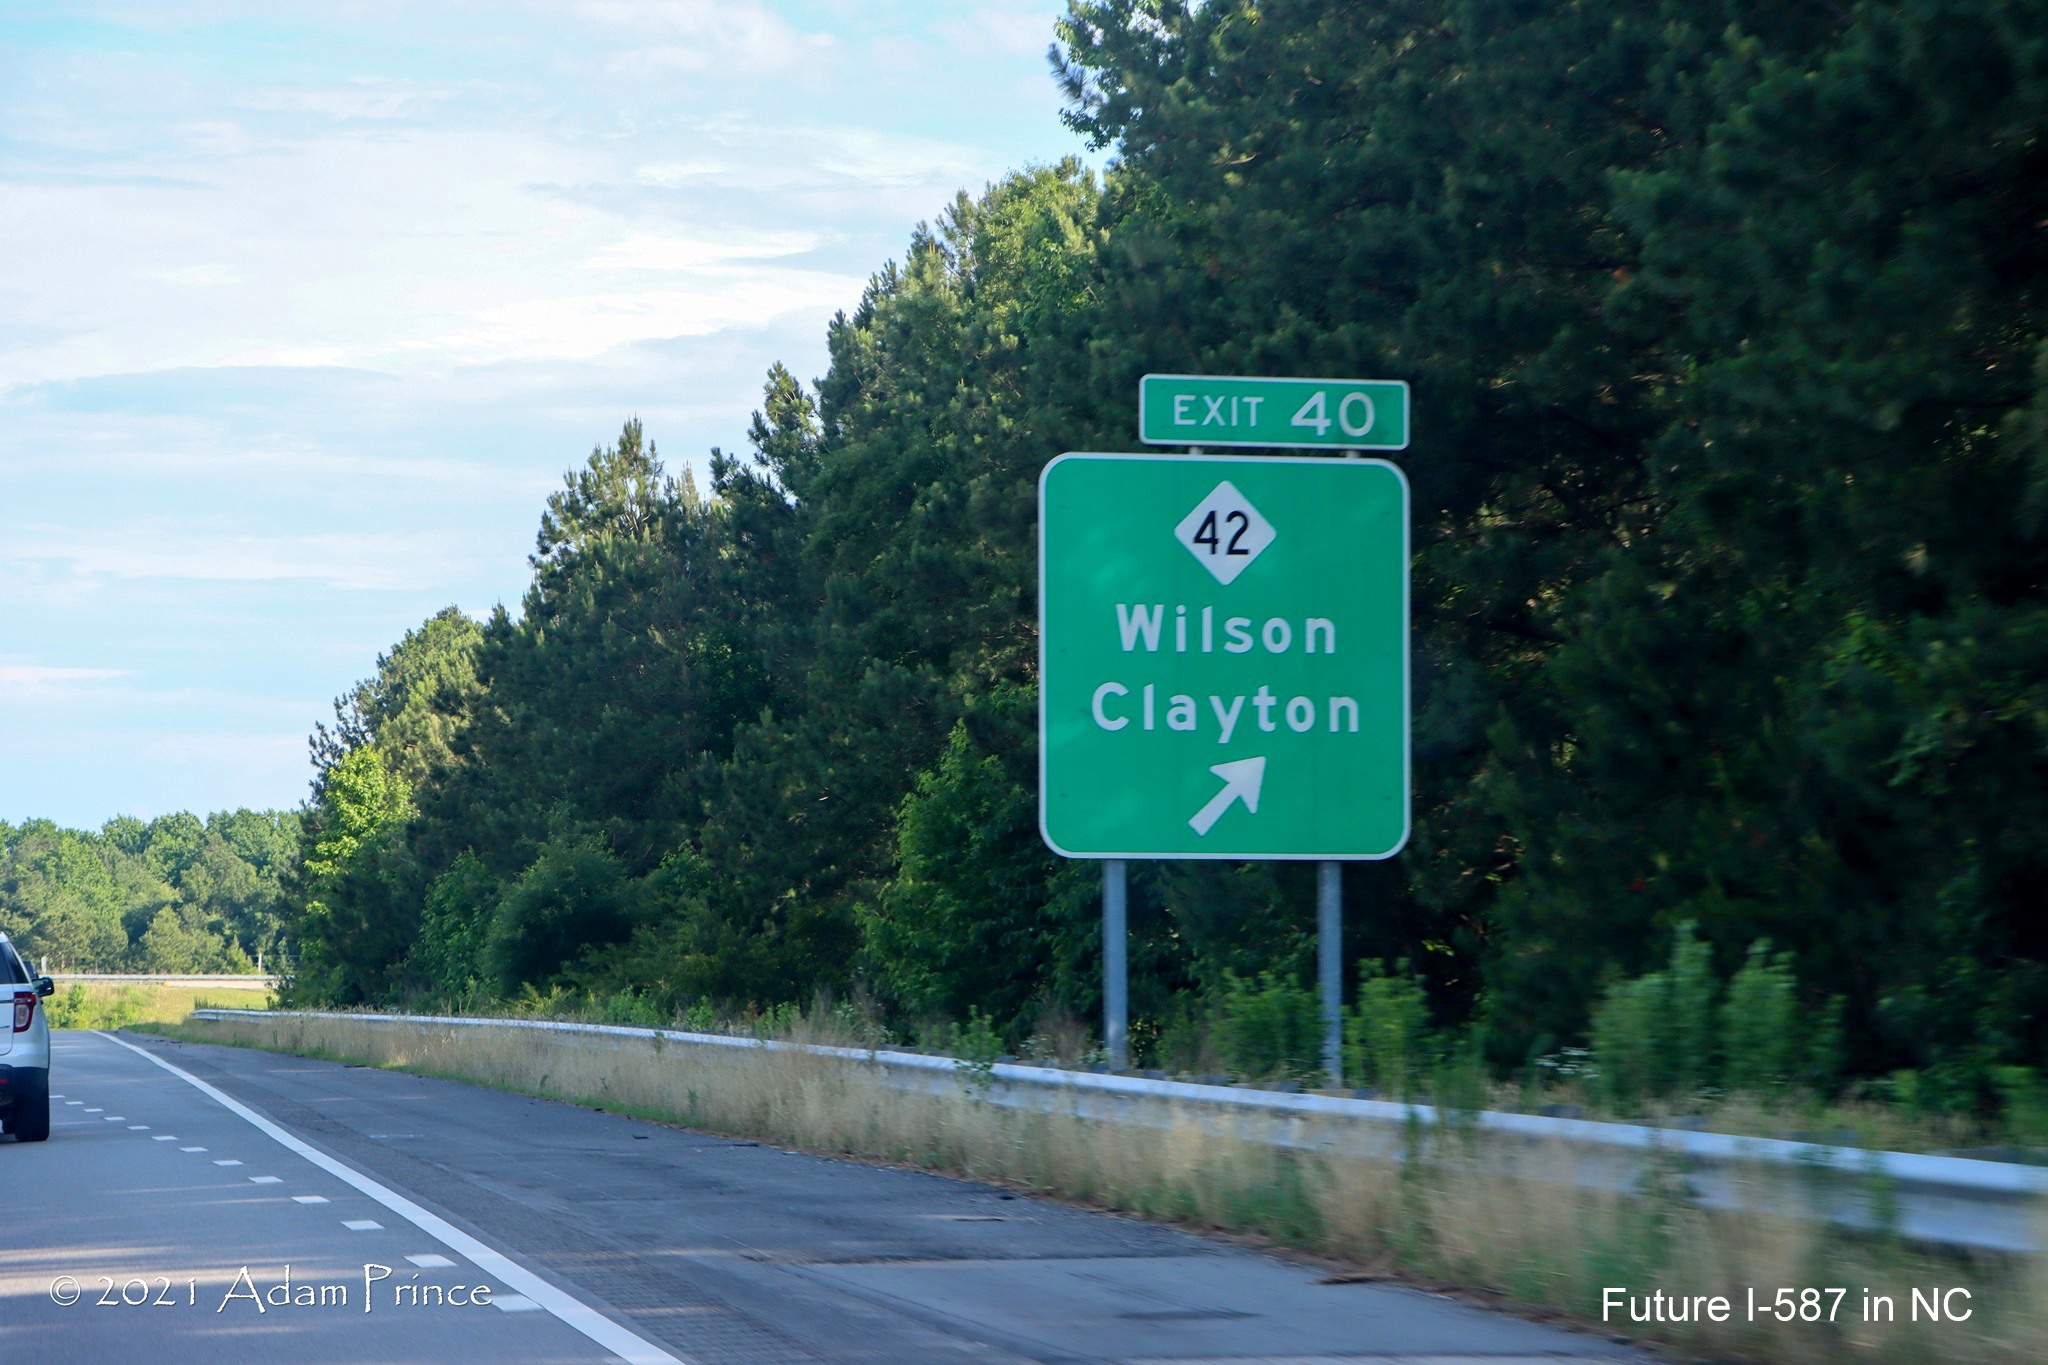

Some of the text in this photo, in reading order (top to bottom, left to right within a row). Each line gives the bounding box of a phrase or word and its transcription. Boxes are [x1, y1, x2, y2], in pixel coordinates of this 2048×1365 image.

[1173, 391, 1375, 437] EXIT 40
[1193, 510, 1250, 555] 42
[1115, 603, 1336, 654] Wilson
[1092, 682, 1359, 744] Clayton
